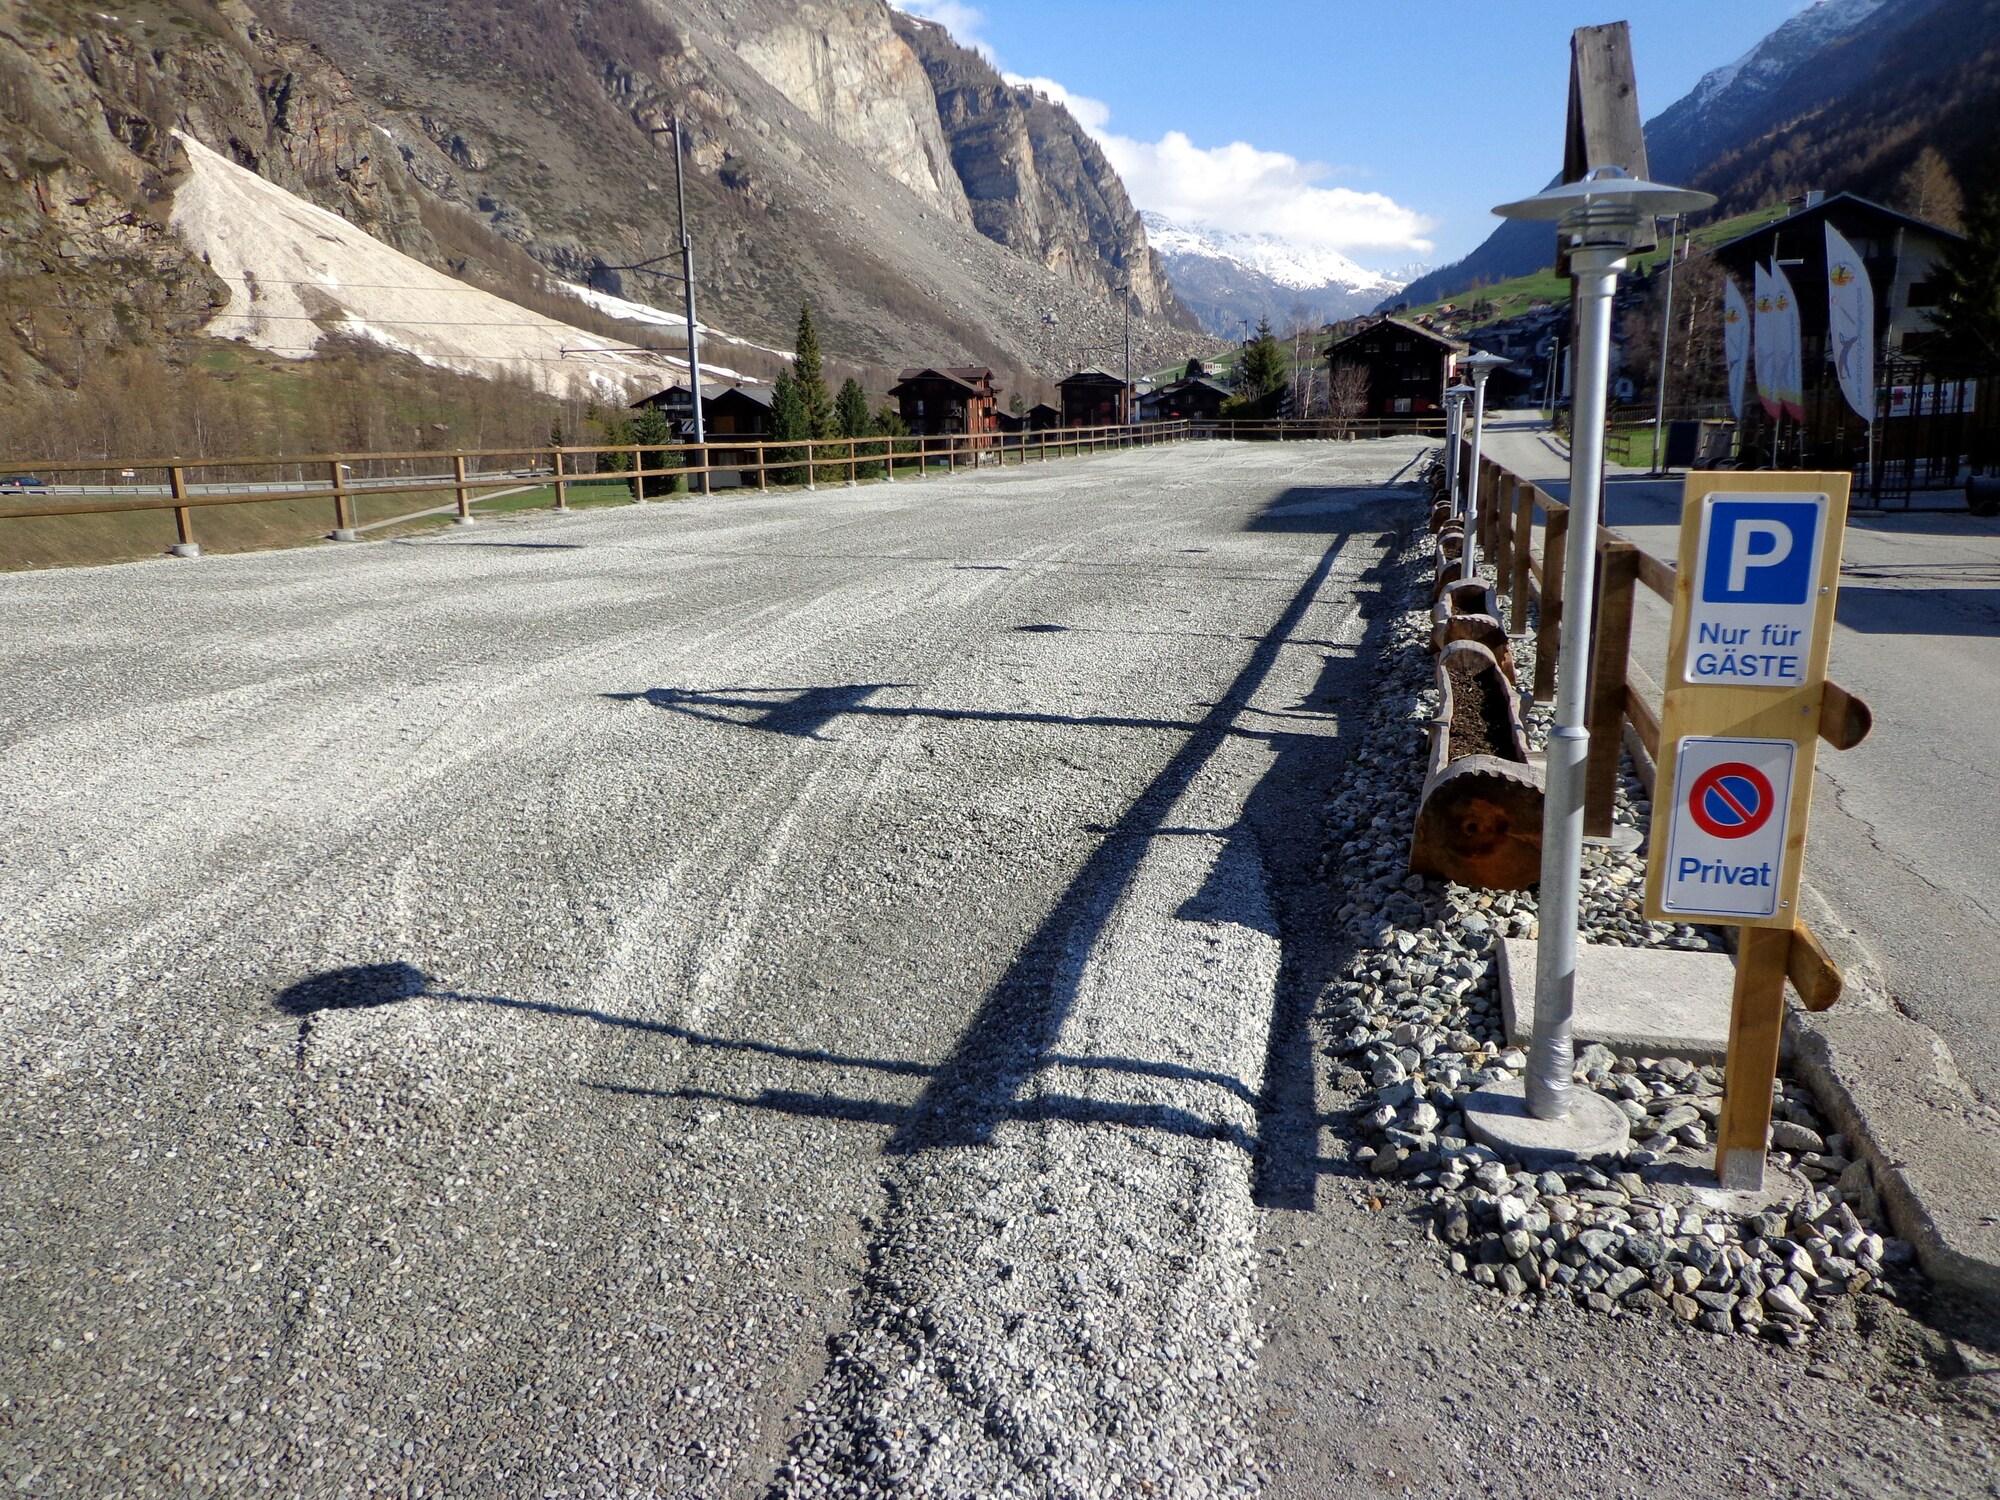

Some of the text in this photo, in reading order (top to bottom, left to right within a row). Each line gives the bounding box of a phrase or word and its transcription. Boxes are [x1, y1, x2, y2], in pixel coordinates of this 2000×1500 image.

[1727, 519, 1793, 592] P
[1699, 622, 1802, 647] Nur für
[1696, 647, 1799, 678] GÄSTE
[1678, 857, 1772, 887] Privat
